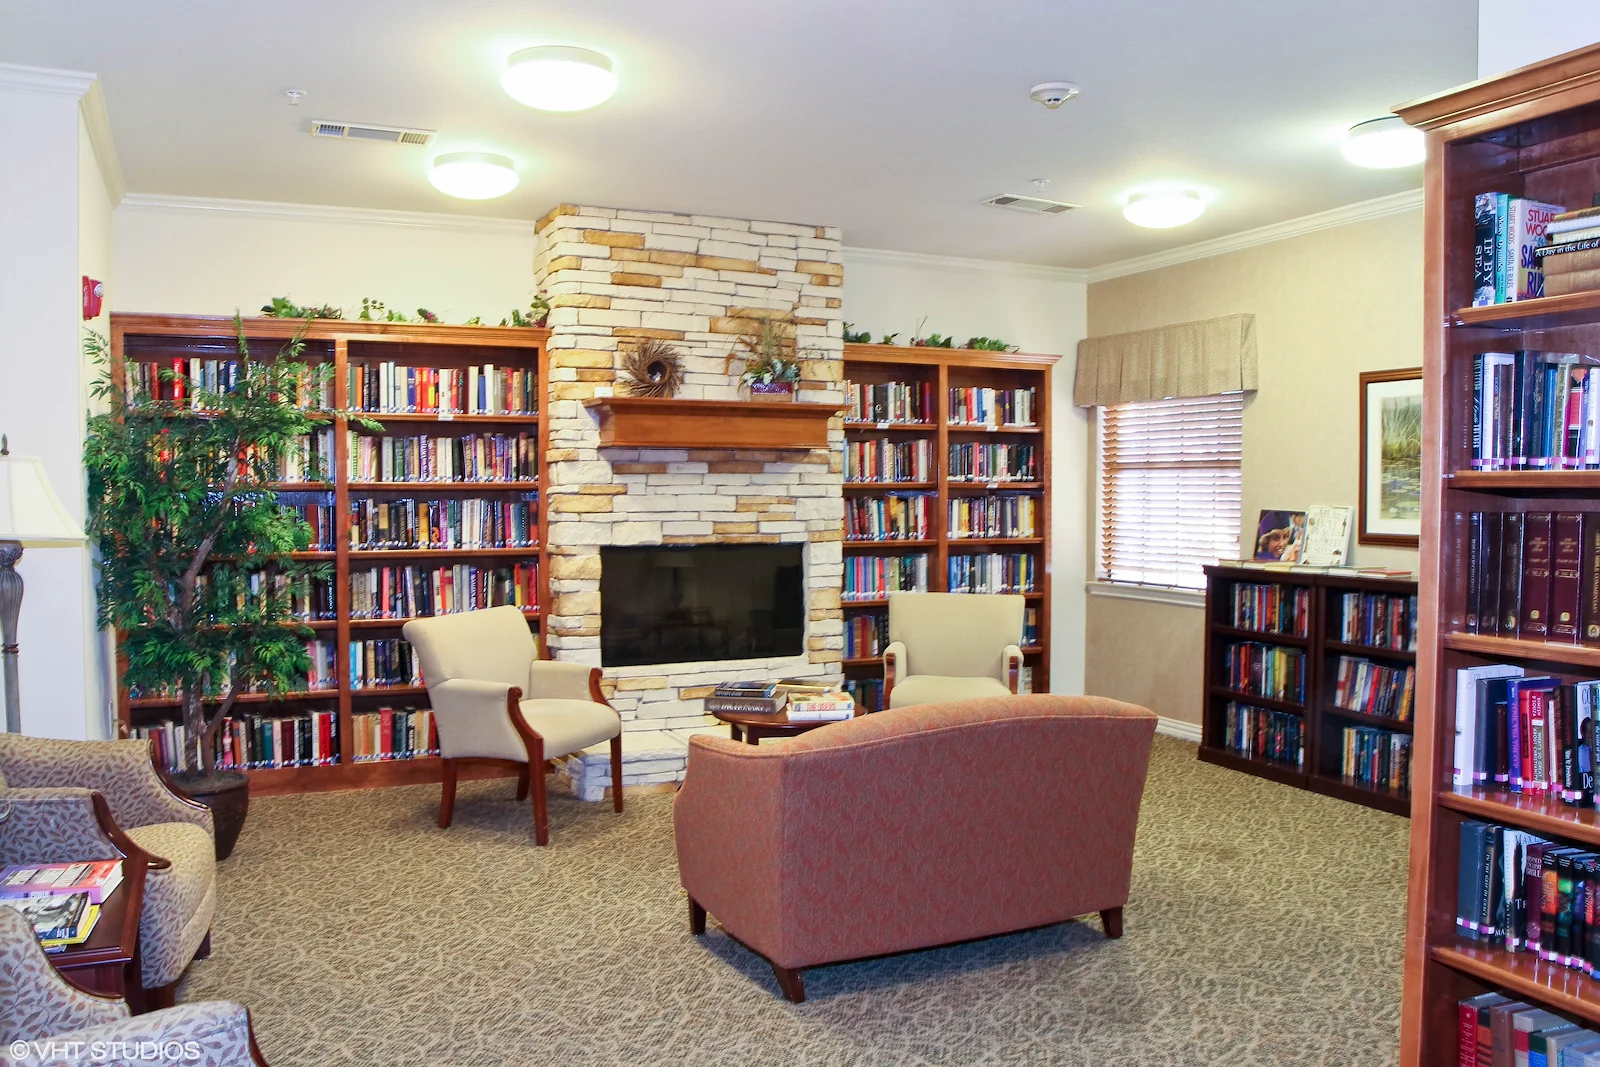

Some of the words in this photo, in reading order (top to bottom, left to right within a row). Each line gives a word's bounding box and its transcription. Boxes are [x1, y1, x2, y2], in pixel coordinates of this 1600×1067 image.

[1528, 209, 1555, 223] STUAR
[1526, 222, 1548, 237] WOO
[1483, 237, 1493, 256] IF
[1542, 248, 1555, 257] Day
[1483, 261, 1493, 284] BY
